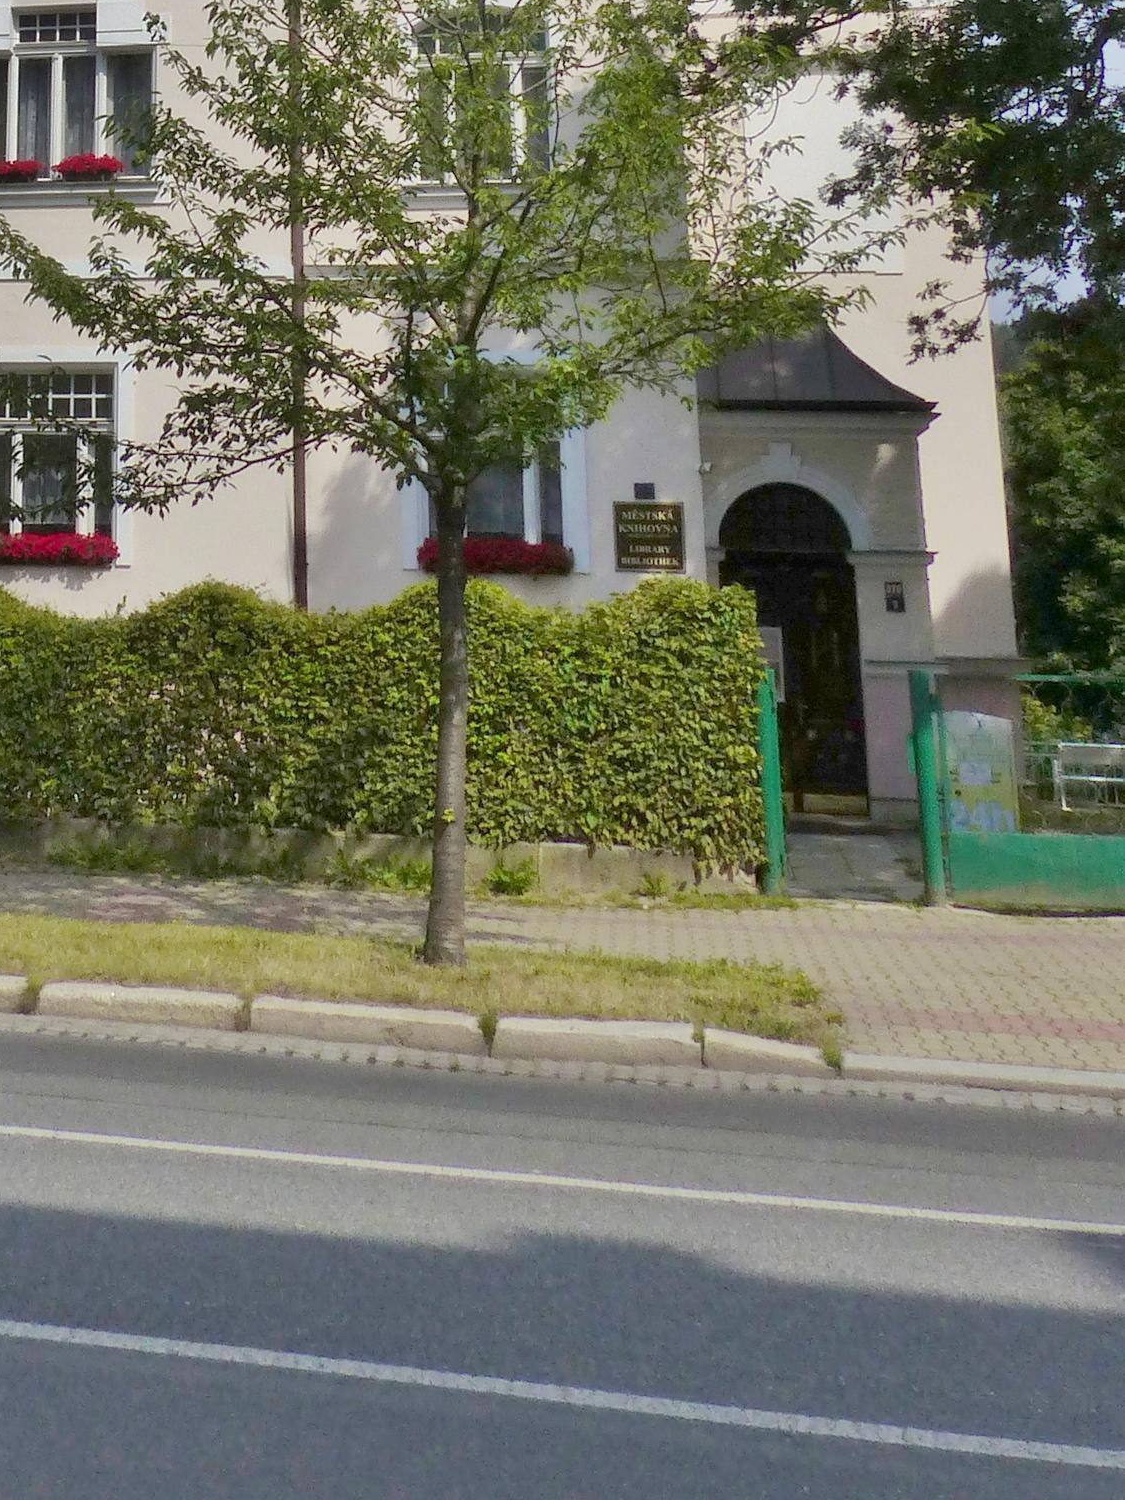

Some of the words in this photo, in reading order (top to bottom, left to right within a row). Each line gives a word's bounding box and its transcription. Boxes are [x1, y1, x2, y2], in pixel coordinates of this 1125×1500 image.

[621, 509, 674, 521] MĚSTSKÁ
[619, 524, 679, 533] KNIHOVNA
[629, 545, 671, 554] LIBRARY
[621, 557, 680, 566] BIBLIOTHEK
